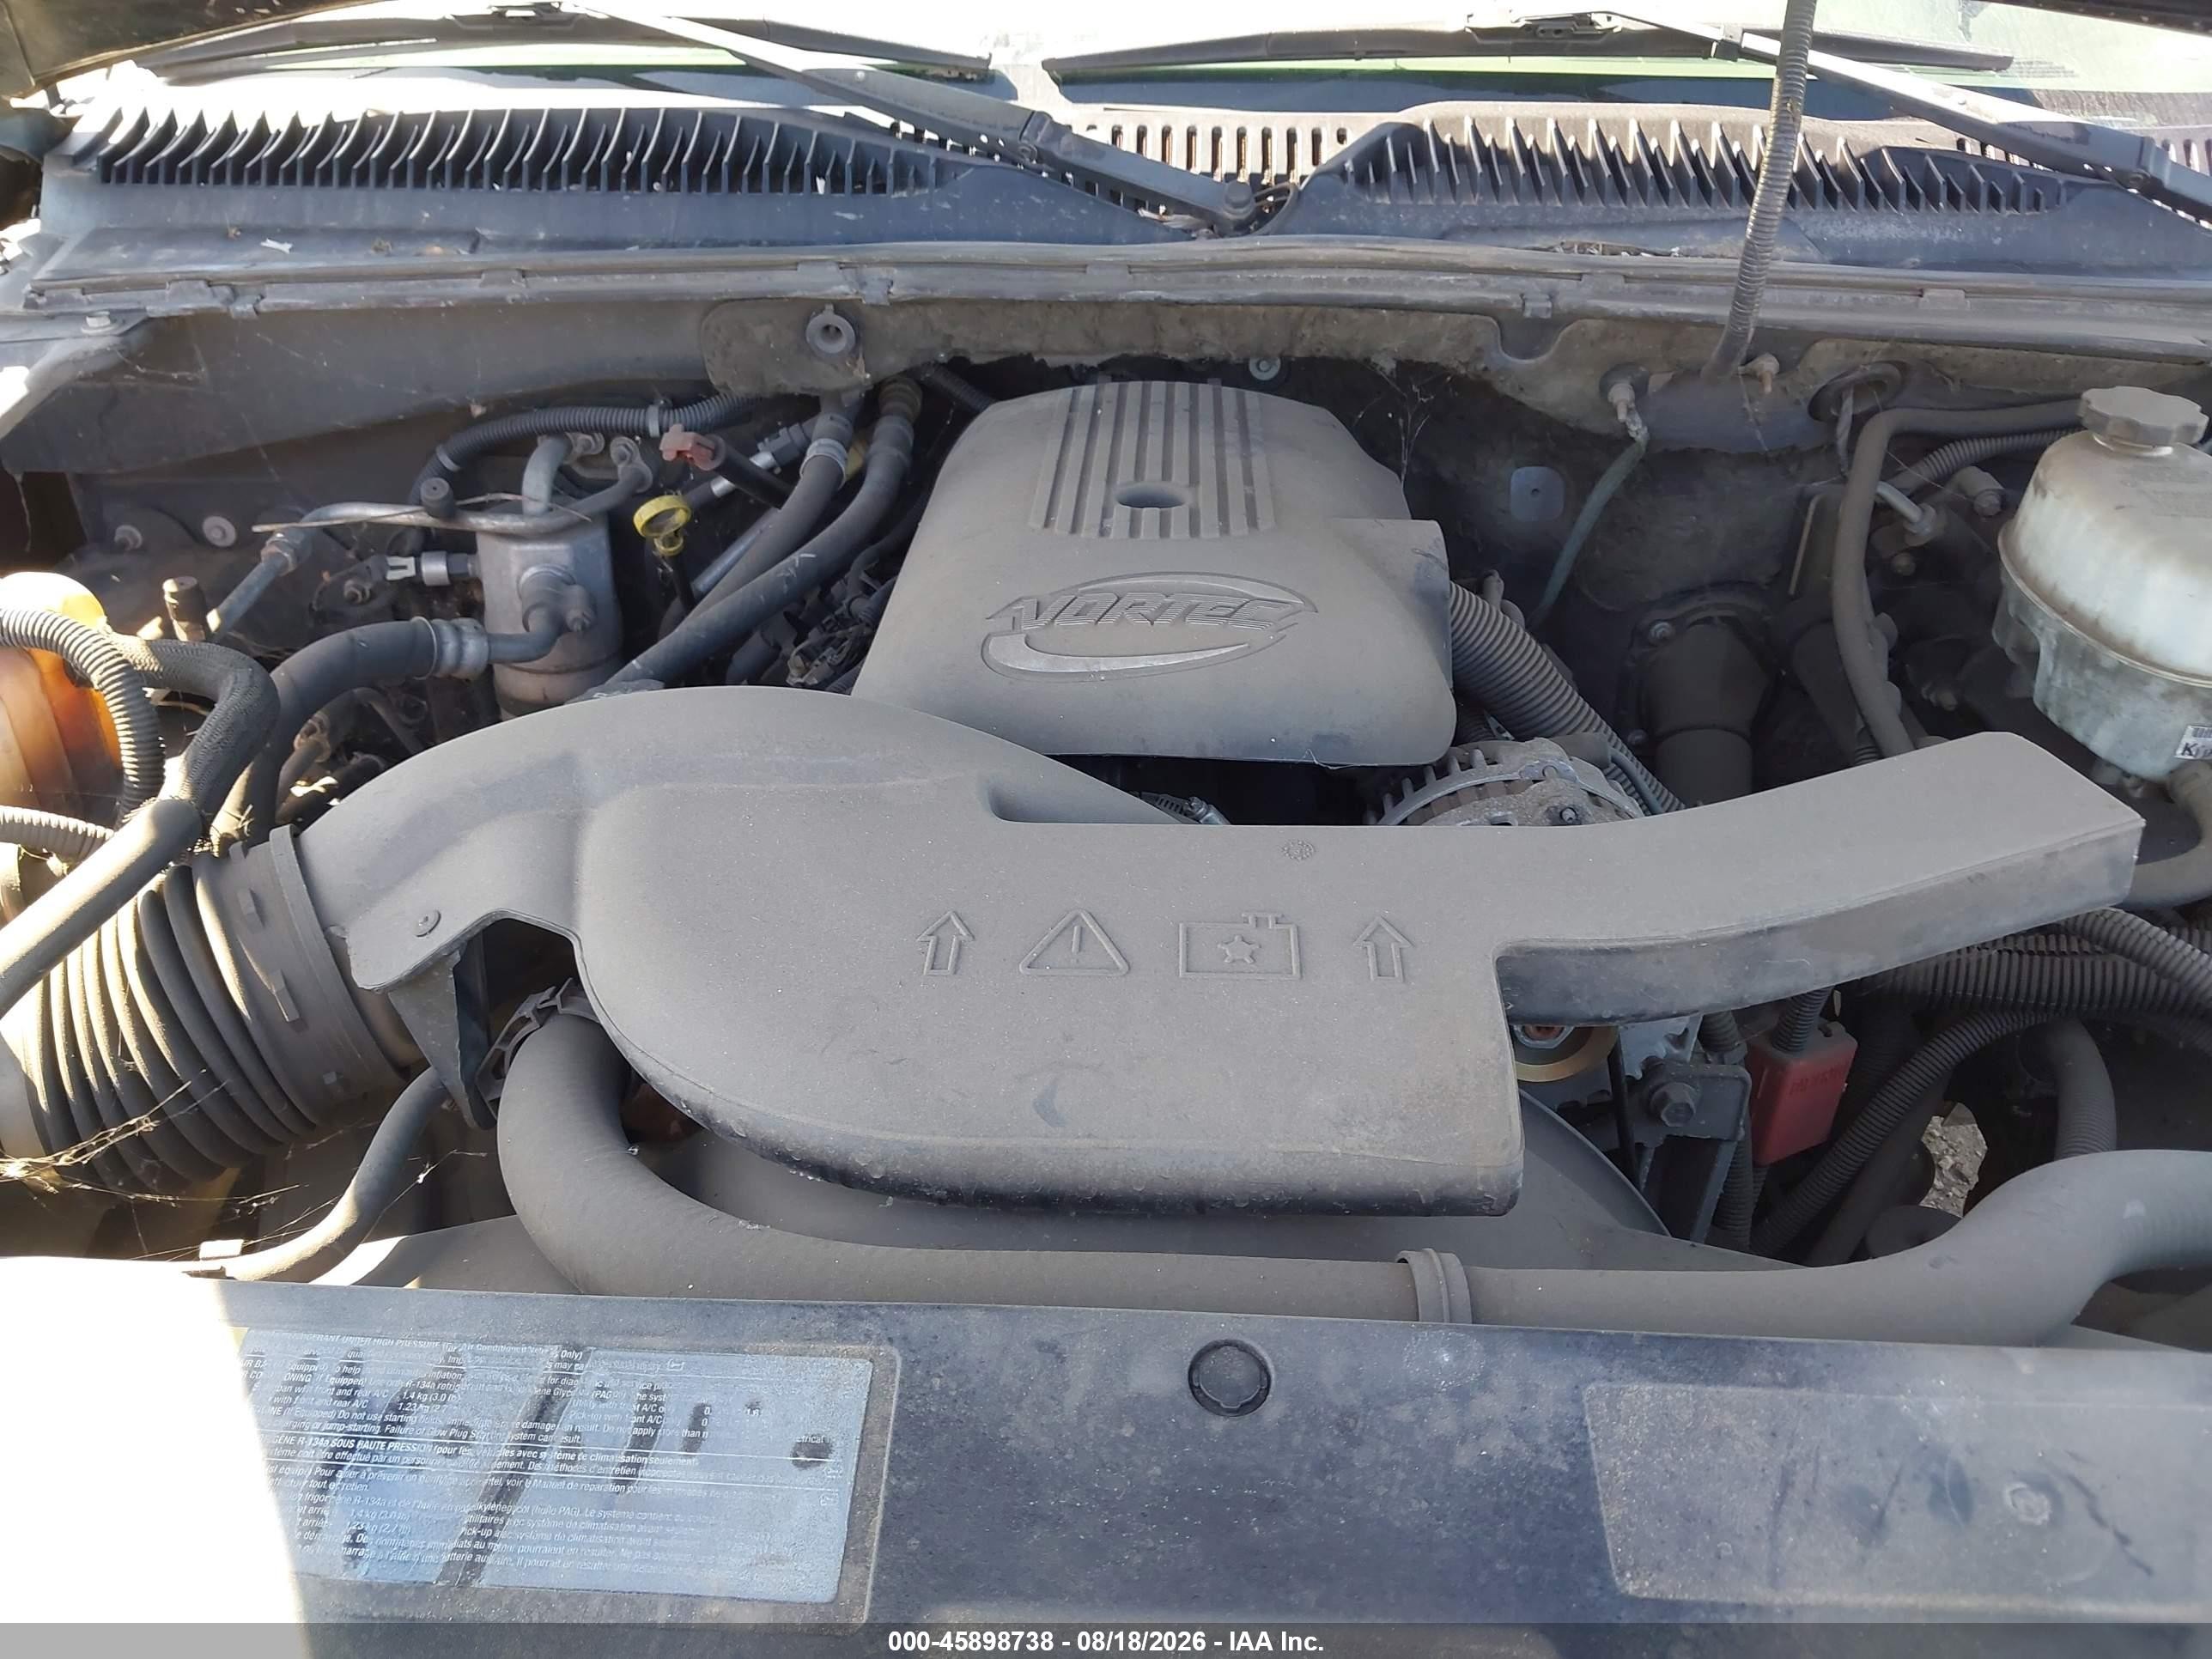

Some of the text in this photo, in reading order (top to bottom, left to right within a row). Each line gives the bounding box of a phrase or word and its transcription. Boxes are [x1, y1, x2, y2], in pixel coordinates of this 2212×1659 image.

[396, 1339, 440, 1349] PRESSURE
[560, 1349, 582, 1360] Only)
[342, 1364, 362, 1375] help
[335, 1386, 353, 1397] and
[402, 1389, 416, 1400] 1.4
[416, 1390, 428, 1402] kg
[429, 1390, 447, 1402] (3.0
[405, 1378, 434, 1389] R-134a
[592, 1389, 611, 1399] (PAG
[273, 1394, 294, 1404] with
[334, 1398, 352, 1408] rear
[352, 1397, 368, 1409] A/C
[398, 1401, 418, 1412] 1.23
[641, 1401, 658, 1413] A/C
[337, 1408, 351, 1419] Do
[351, 1410, 367, 1421] not
[367, 1413, 382, 1422] use
[383, 1412, 417, 1425] starting
[520, 1419, 556, 1432] damage
[632, 1425, 657, 1438] apply
[681, 1428, 701, 1438] than
[647, 1413, 663, 1424] A/C
[312, 1420, 323, 1430] or
[323, 1419, 380, 1436] jump-starting.
[384, 1423, 416, 1435] Failure
[448, 1427, 469, 1440] Plug
[506, 1431, 536, 1443] ystem
[537, 1432, 552, 1442] can
[297, 1435, 330, 1447] R-134a
[330, 1437, 356, 1449] SOUS
[356, 1438, 386, 1450] HAUTE
[386, 1440, 431, 1453] PRESSIO
[433, 1443, 457, 1456] (pour
[515, 1448, 539, 1458] avec
[539, 1448, 577, 1462] sytème
[589, 1450, 647, 1466] climasation
[334, 1449, 372, 1462] effectué
[372, 1454, 388, 1464] par
[389, 1455, 402, 1464] un
[526, 1460, 543, 1471] Des
[589, 1462, 637, 1477] d'enretien
[278, 1464, 313, 1478] éqip)
[314, 1466, 336, 1477] Pour
[359, 1468, 368, 1480] à
[506, 1477, 524, 1487] voir
[566, 1480, 579, 1490] de
[307, 1477, 368, 1492] tout eretien.
[303, 1490, 352, 1505] frigorène
[354, 1495, 386, 1507] R-134a
[583, 1506, 597, 1516] Le
[467, 1513, 505, 1527] tilitaires
[355, 1532, 372, 1545] De
[472, 1540, 486, 1550] au
[441, 1550, 473, 1563] tterie
